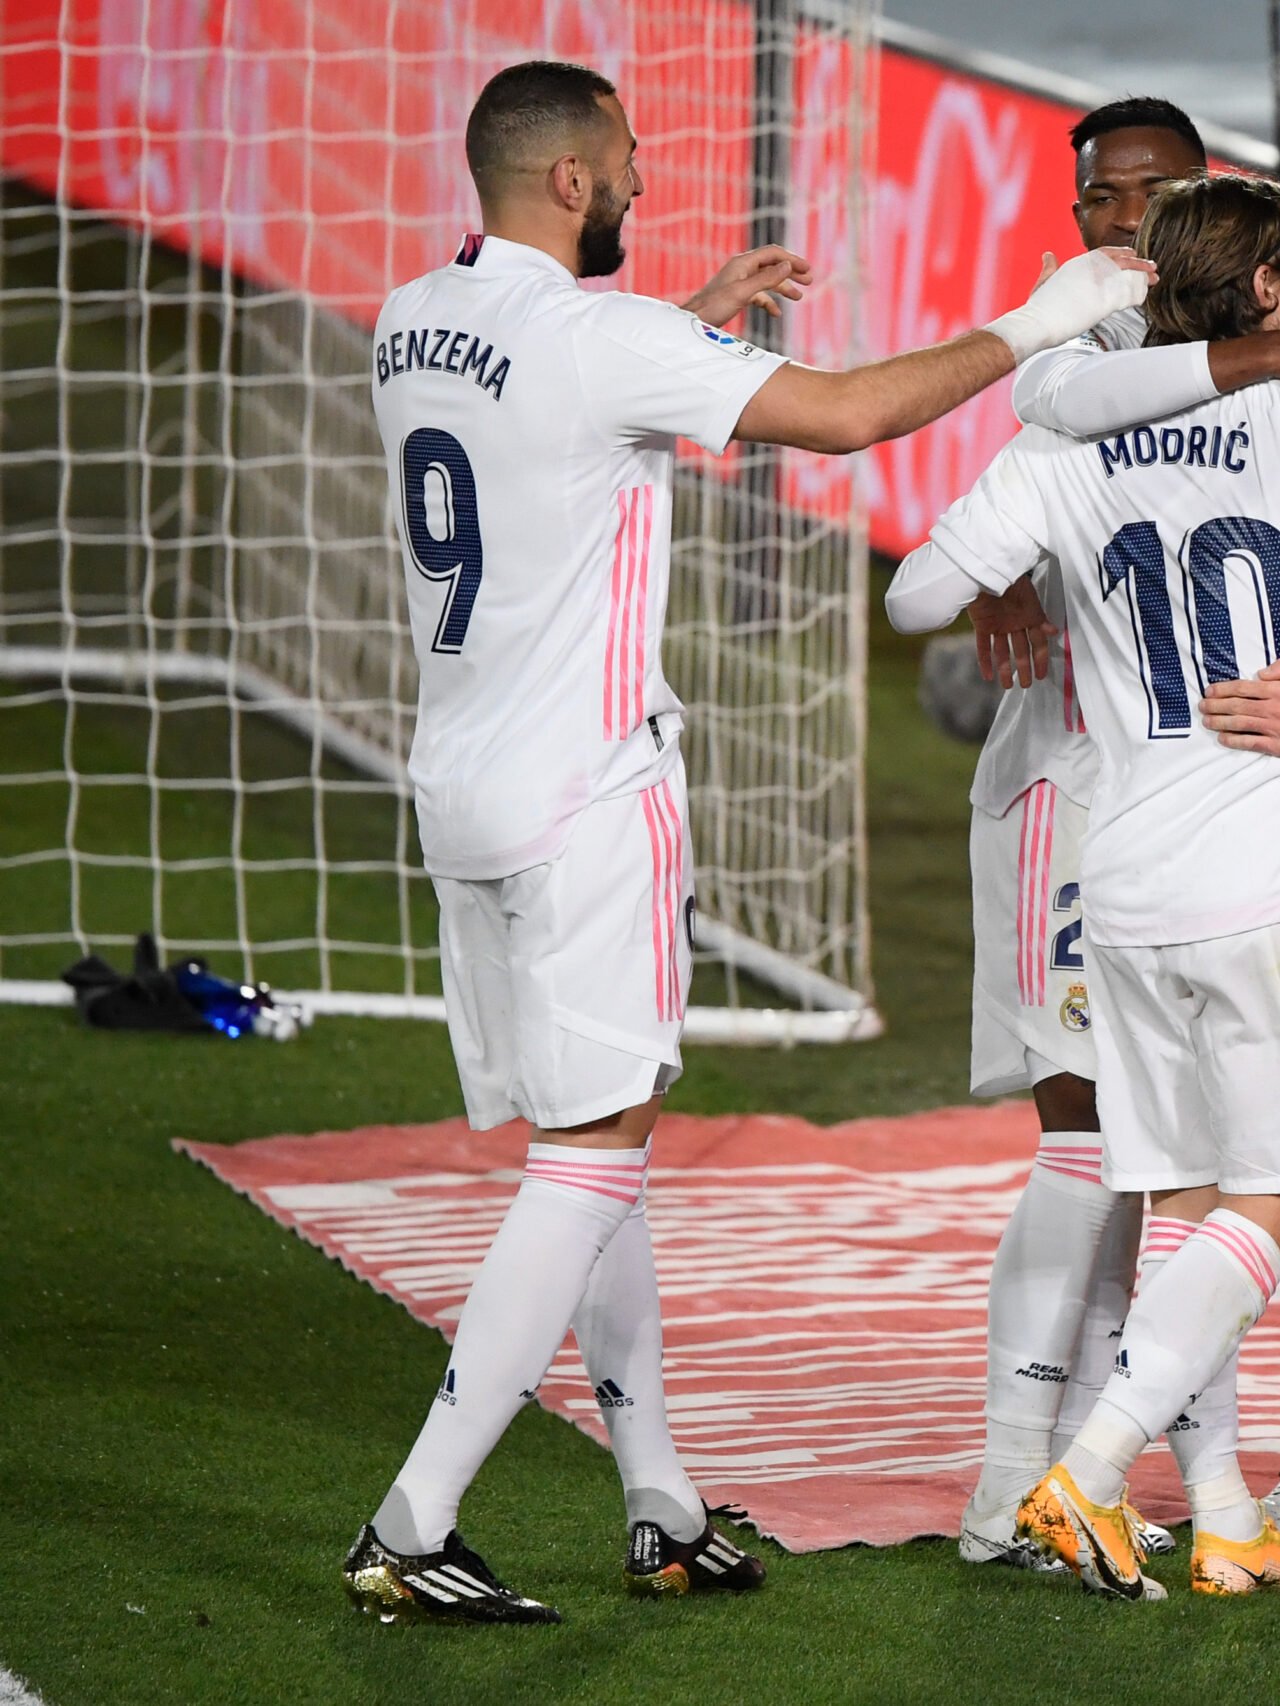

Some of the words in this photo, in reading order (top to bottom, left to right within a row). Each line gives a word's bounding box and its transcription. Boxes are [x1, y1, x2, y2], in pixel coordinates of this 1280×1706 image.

[375, 328, 511, 402] BENZEMA
[1096, 421, 1250, 479] MODRIĆ
[401, 427, 483, 655] 9
[1028, 1362, 1064, 1375] REAL
